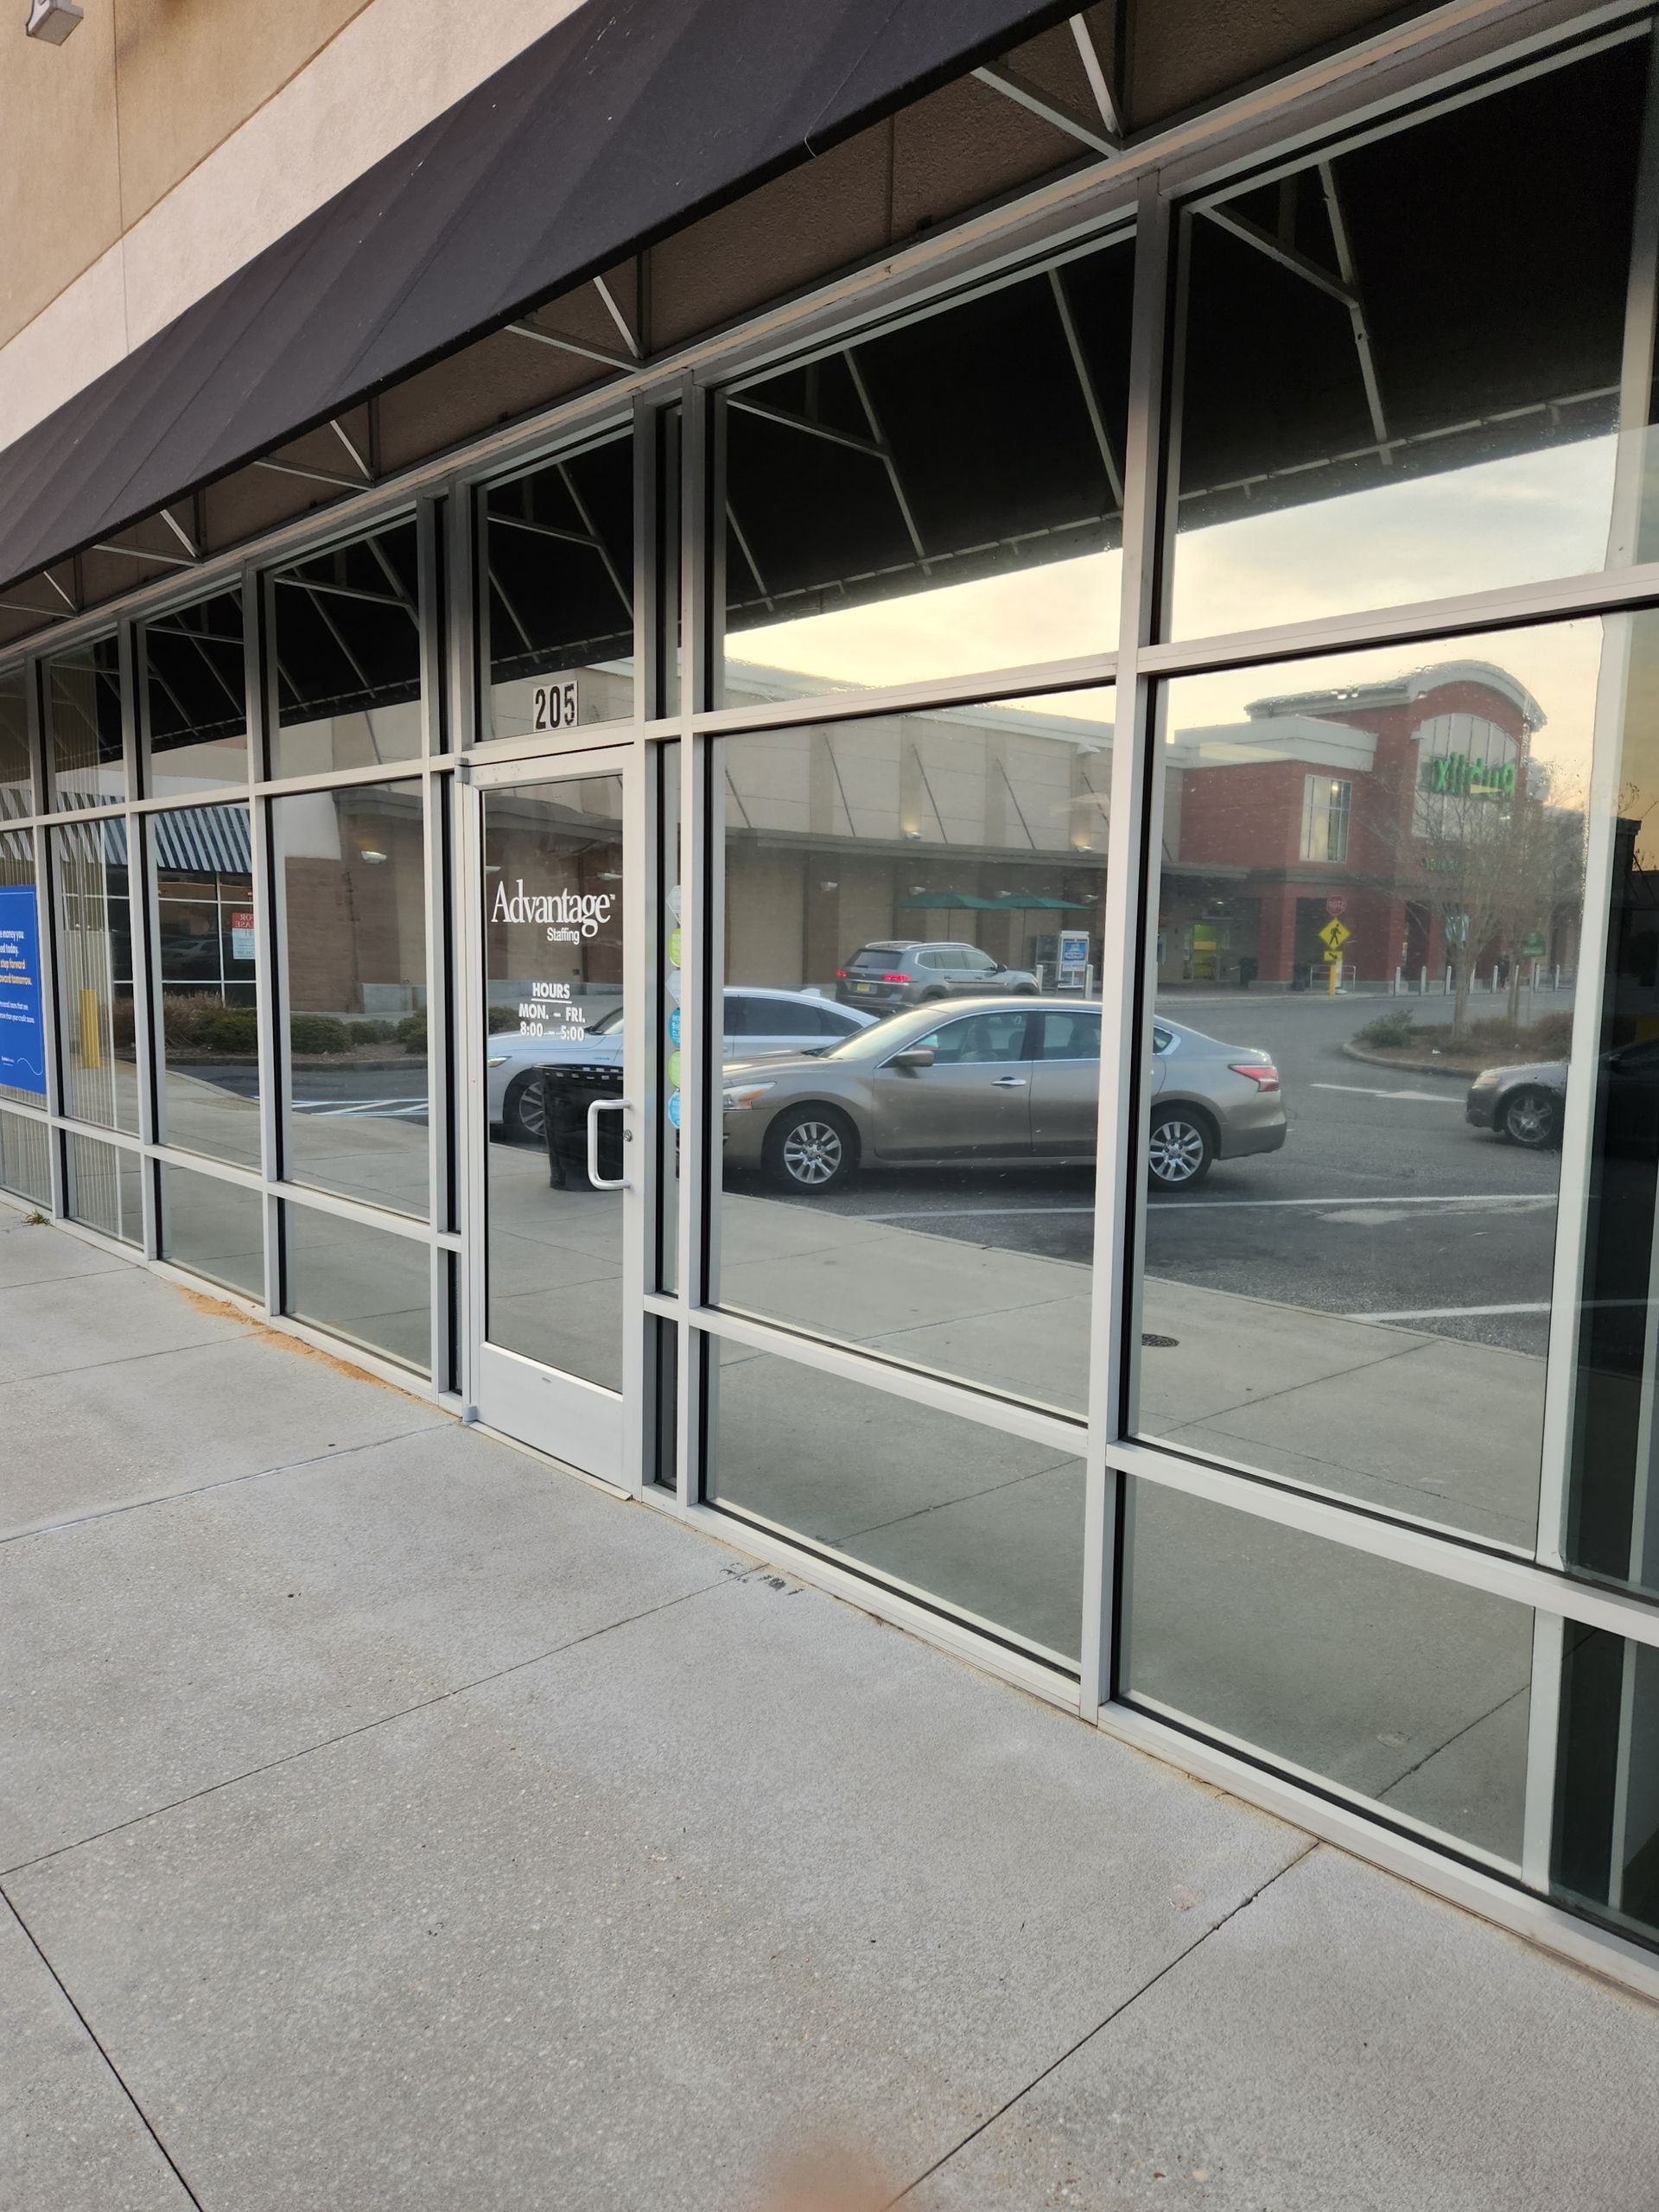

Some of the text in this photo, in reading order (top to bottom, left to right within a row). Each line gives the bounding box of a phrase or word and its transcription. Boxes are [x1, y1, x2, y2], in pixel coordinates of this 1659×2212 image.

[535, 683, 575, 729] 205
[491, 879, 611, 938] Advantage
[547, 927, 580, 944] Staffing
[532, 982, 570, 1000] HOURS
[518, 1003, 549, 1020] MON.
[565, 1007, 586, 1023] FRI.
[519, 1022, 543, 1038] 8:00
[560, 1027, 584, 1042] 5:00
